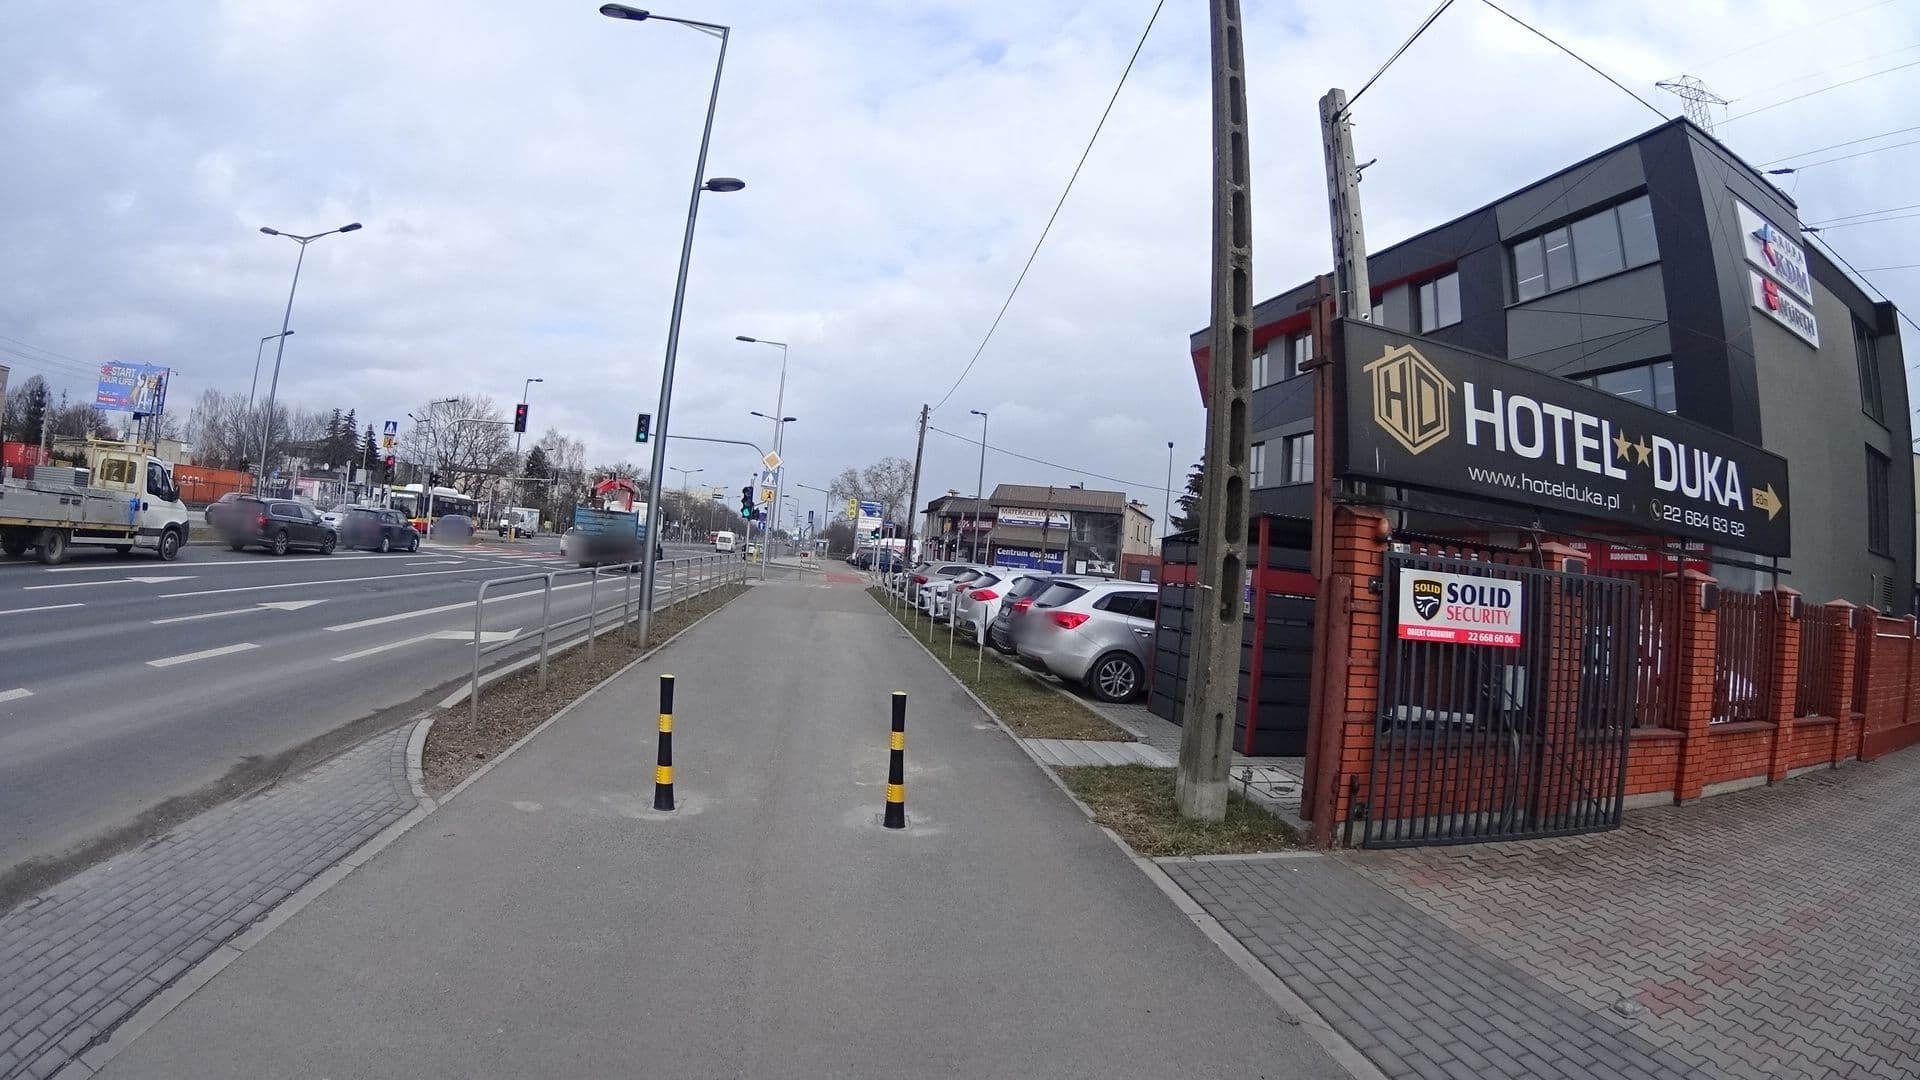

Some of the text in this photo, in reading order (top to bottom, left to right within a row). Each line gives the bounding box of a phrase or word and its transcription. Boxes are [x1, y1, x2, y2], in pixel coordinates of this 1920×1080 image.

[1463, 381, 1745, 512] HOTEL DUKA
[1468, 465, 1621, 511] www.hotelduka.pl
[1663, 504, 1745, 537] 22 664 63 52
[997, 547, 1028, 557] Centrum
[1414, 583, 1441, 594] SOLID
[1447, 582, 1512, 609] SOLID
[1446, 605, 1511, 625] SECURITY
[1468, 632, 1479, 641] 22
[1479, 633, 1493, 642] 668
[1494, 634, 1504, 643] 60
[1504, 635, 1514, 644] 06
